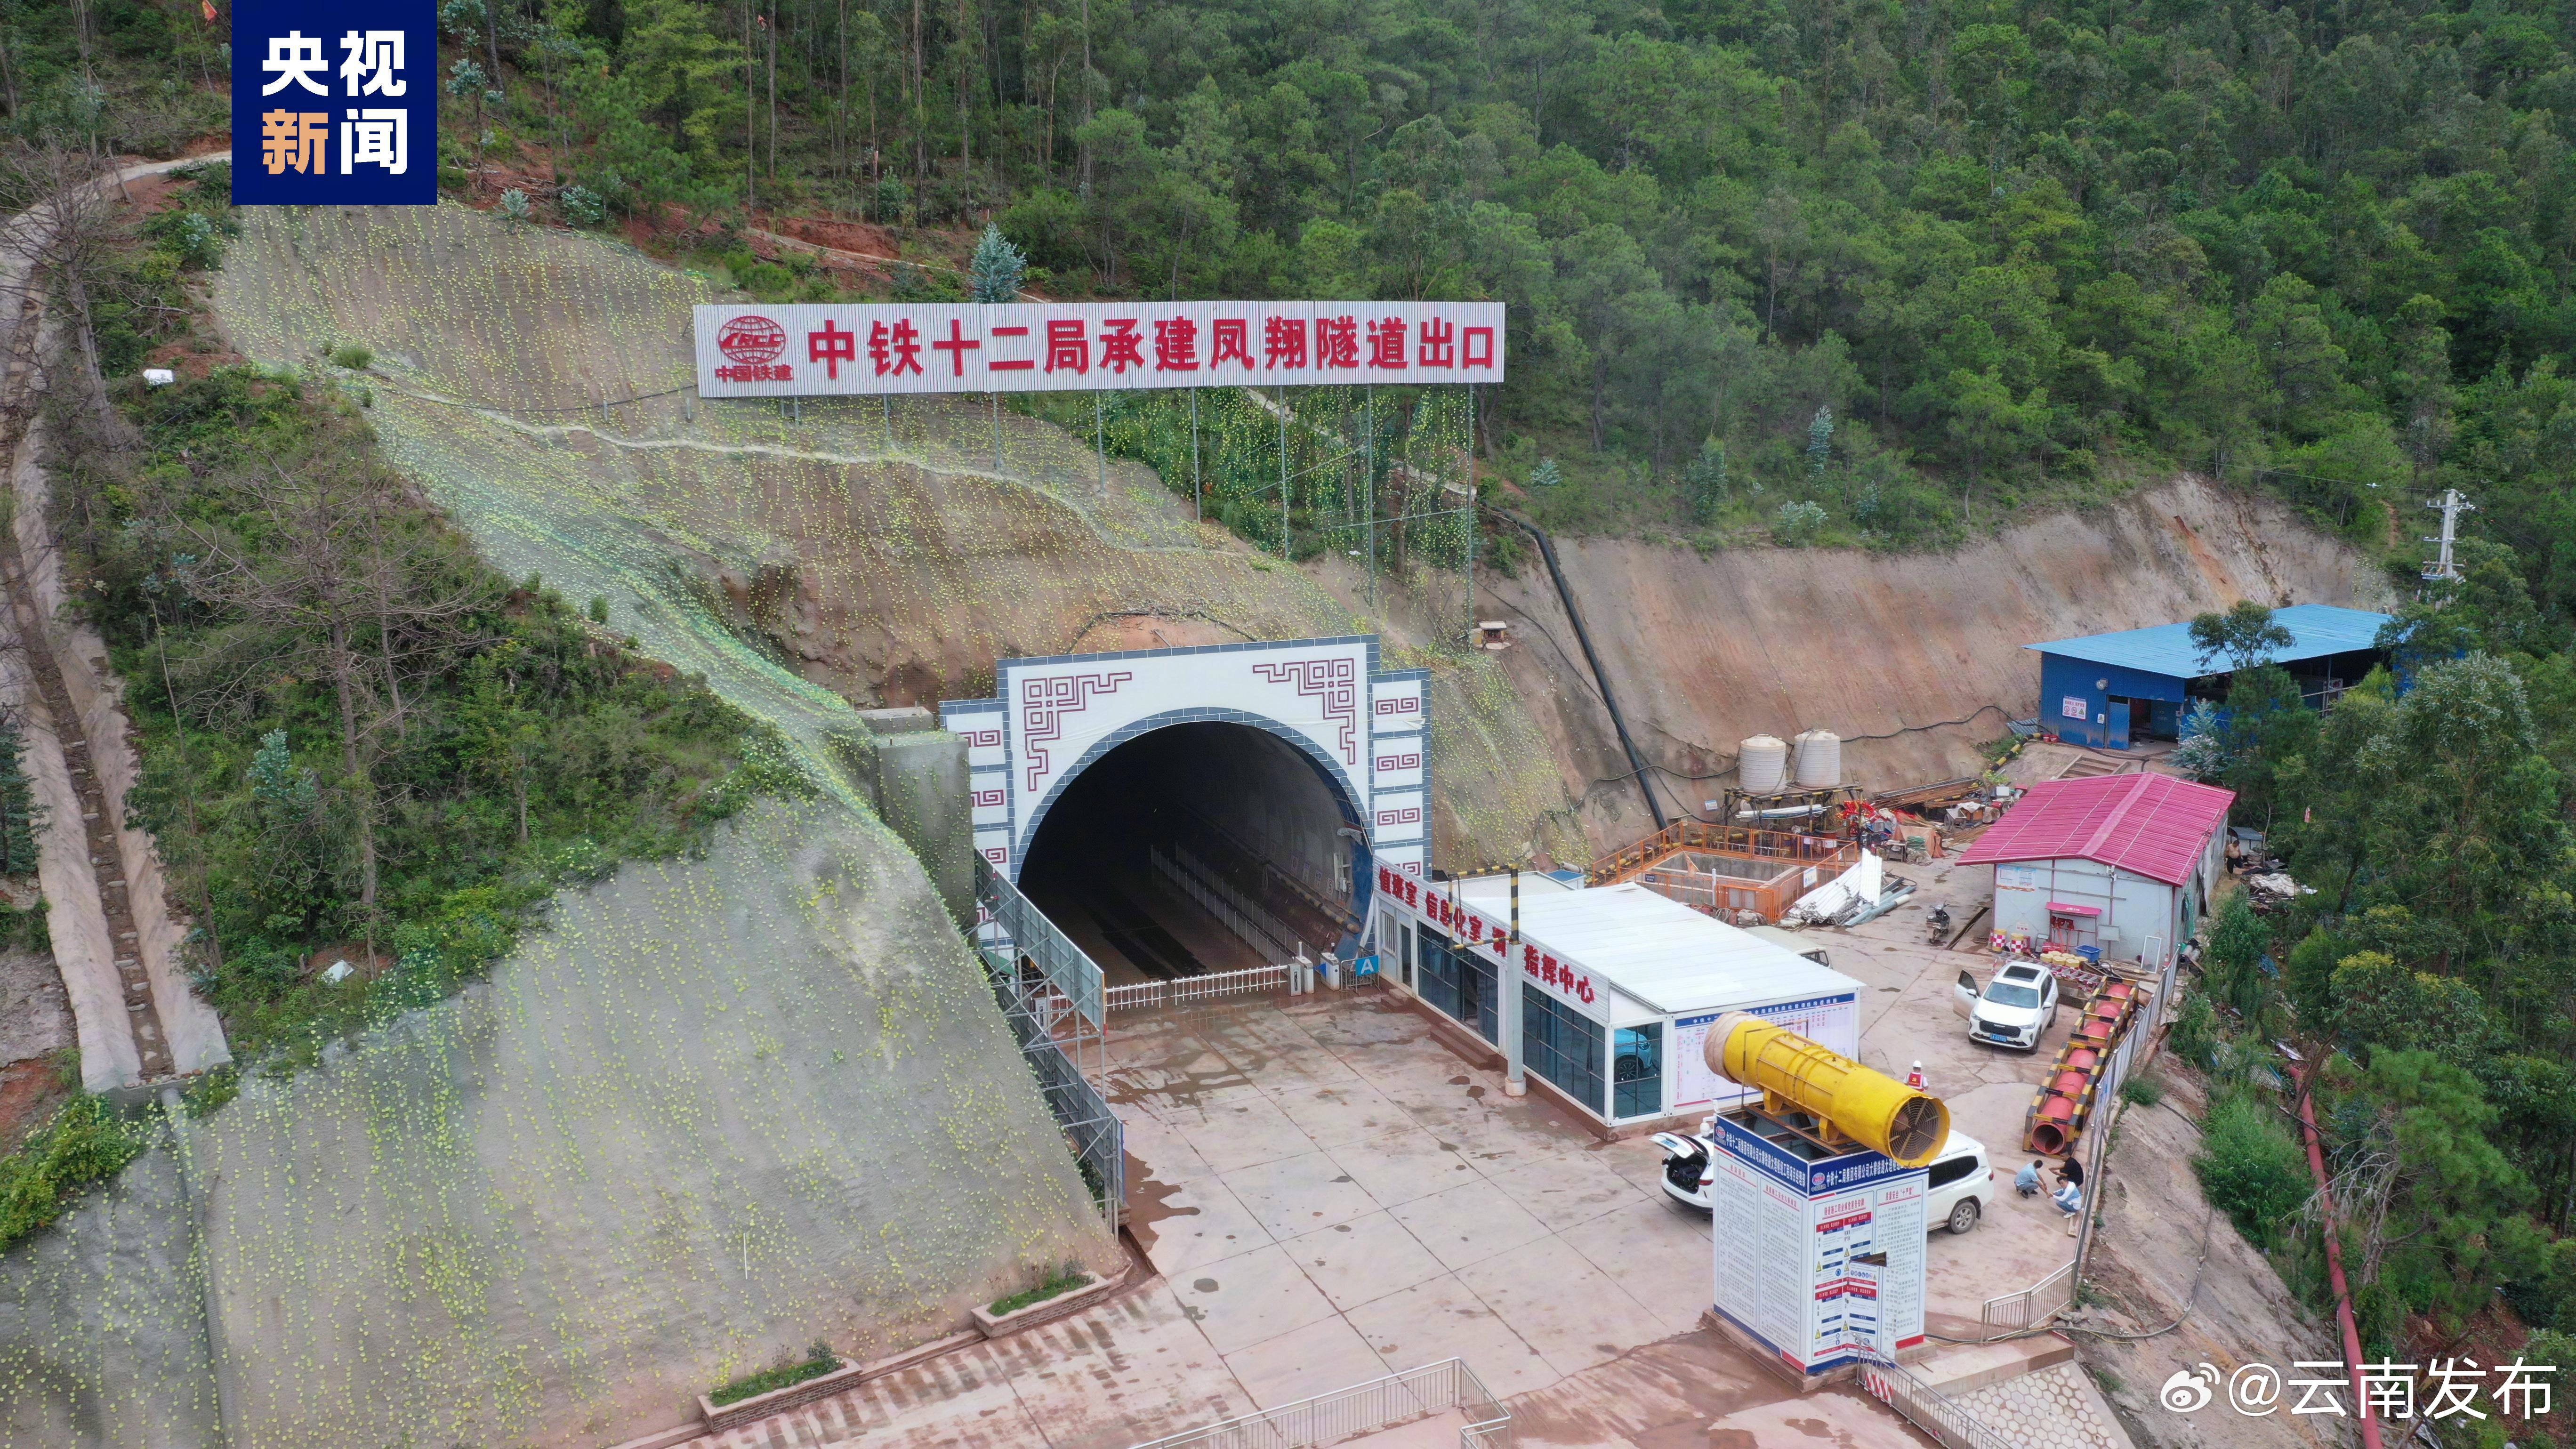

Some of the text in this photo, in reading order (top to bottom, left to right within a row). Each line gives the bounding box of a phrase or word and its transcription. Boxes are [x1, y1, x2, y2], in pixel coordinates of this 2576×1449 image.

[808, 315, 1494, 379] 中铁十二局承建凤翔隧道出口
[715, 365, 793, 383] 中国铁建
[1378, 865, 1595, 1004] 值班室 信息化室 调指挥中心
[1360, 958, 1374, 974] A
